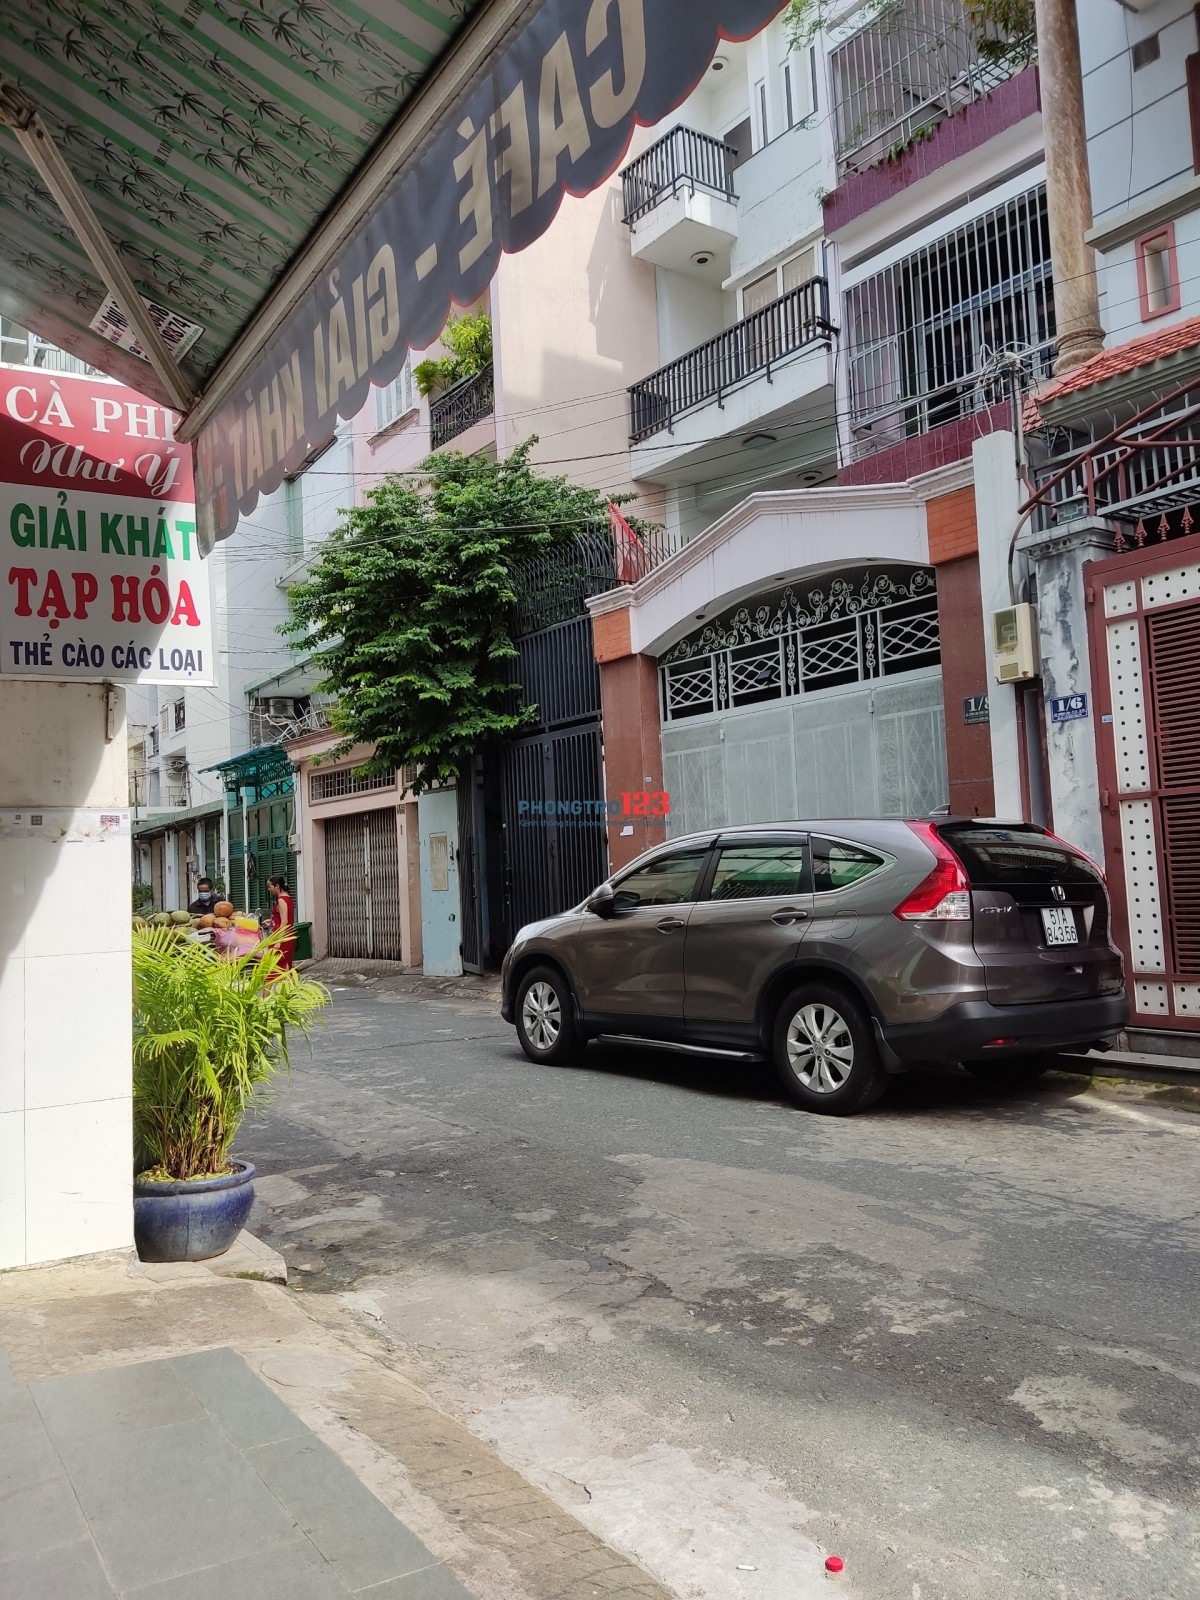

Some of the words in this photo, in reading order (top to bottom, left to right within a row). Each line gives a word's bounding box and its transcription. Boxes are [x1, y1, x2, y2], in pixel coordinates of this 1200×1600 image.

[6, 380, 75, 428] CÀ
[19, 439, 126, 483] Như
[134, 447, 181, 495] Ý
[10, 491, 87, 552] GIẢI
[101, 506, 196, 561] KHÁT
[8, 566, 98, 629] TẠP
[111, 565, 201, 627] HÓA
[10, 633, 53, 666] THẺ
[62, 638, 105, 668] CÀO
[111, 640, 152, 670] CÁC
[159, 649, 203, 676] LOẠI
[1057, 697, 1083, 712] 1/6
[1046, 926, 1077, 943] 843.56
[1048, 909, 1068, 925] 51A
